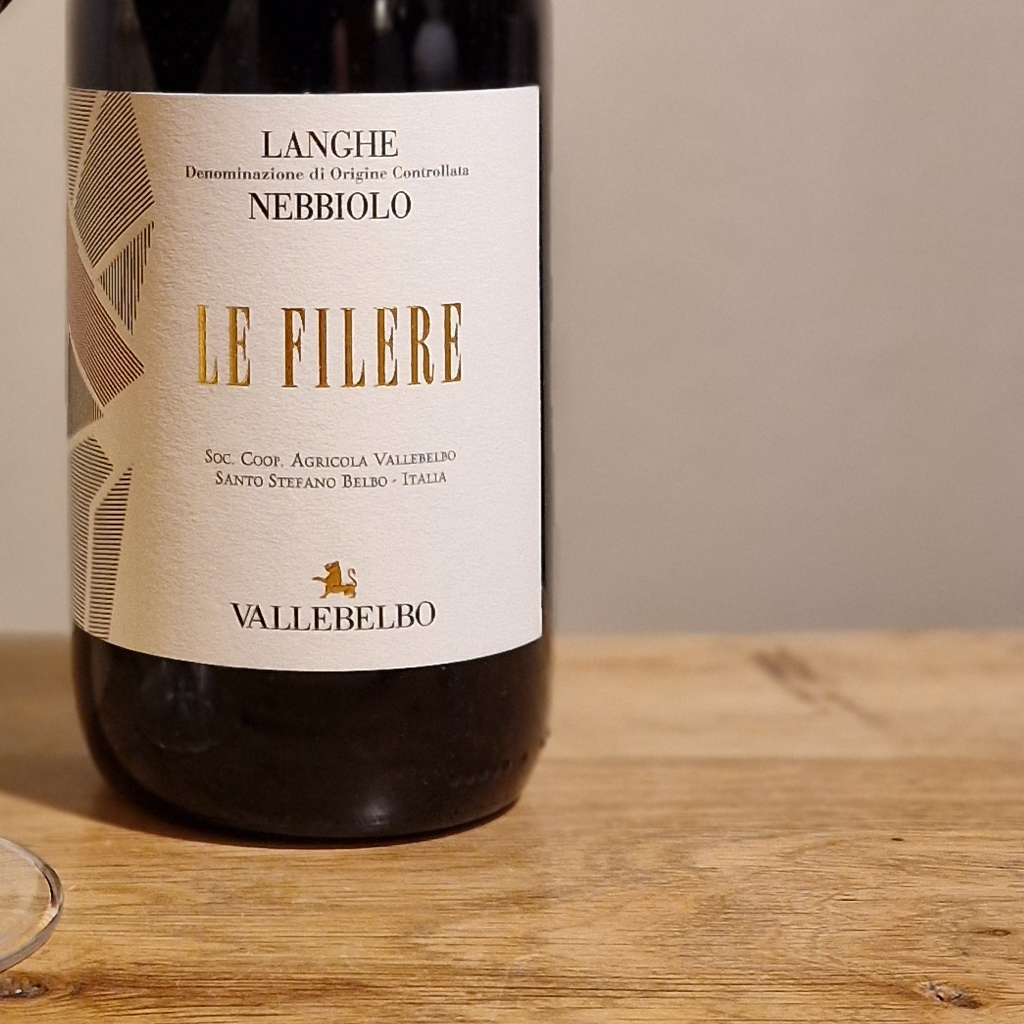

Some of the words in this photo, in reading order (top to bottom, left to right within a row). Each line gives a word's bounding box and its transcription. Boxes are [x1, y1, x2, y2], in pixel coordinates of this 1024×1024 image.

[261, 129, 399, 159] LANGHE
[185, 164, 305, 181] Denominazione
[309, 166, 325, 181] di
[329, 167, 388, 184] Origine
[392, 164, 470, 180] Controllata
[248, 191, 412, 221] NEBBIOLO
[196, 303, 251, 387] LE
[281, 302, 462, 388] FILERE
[229, 600, 437, 632] VALLEBELBO
